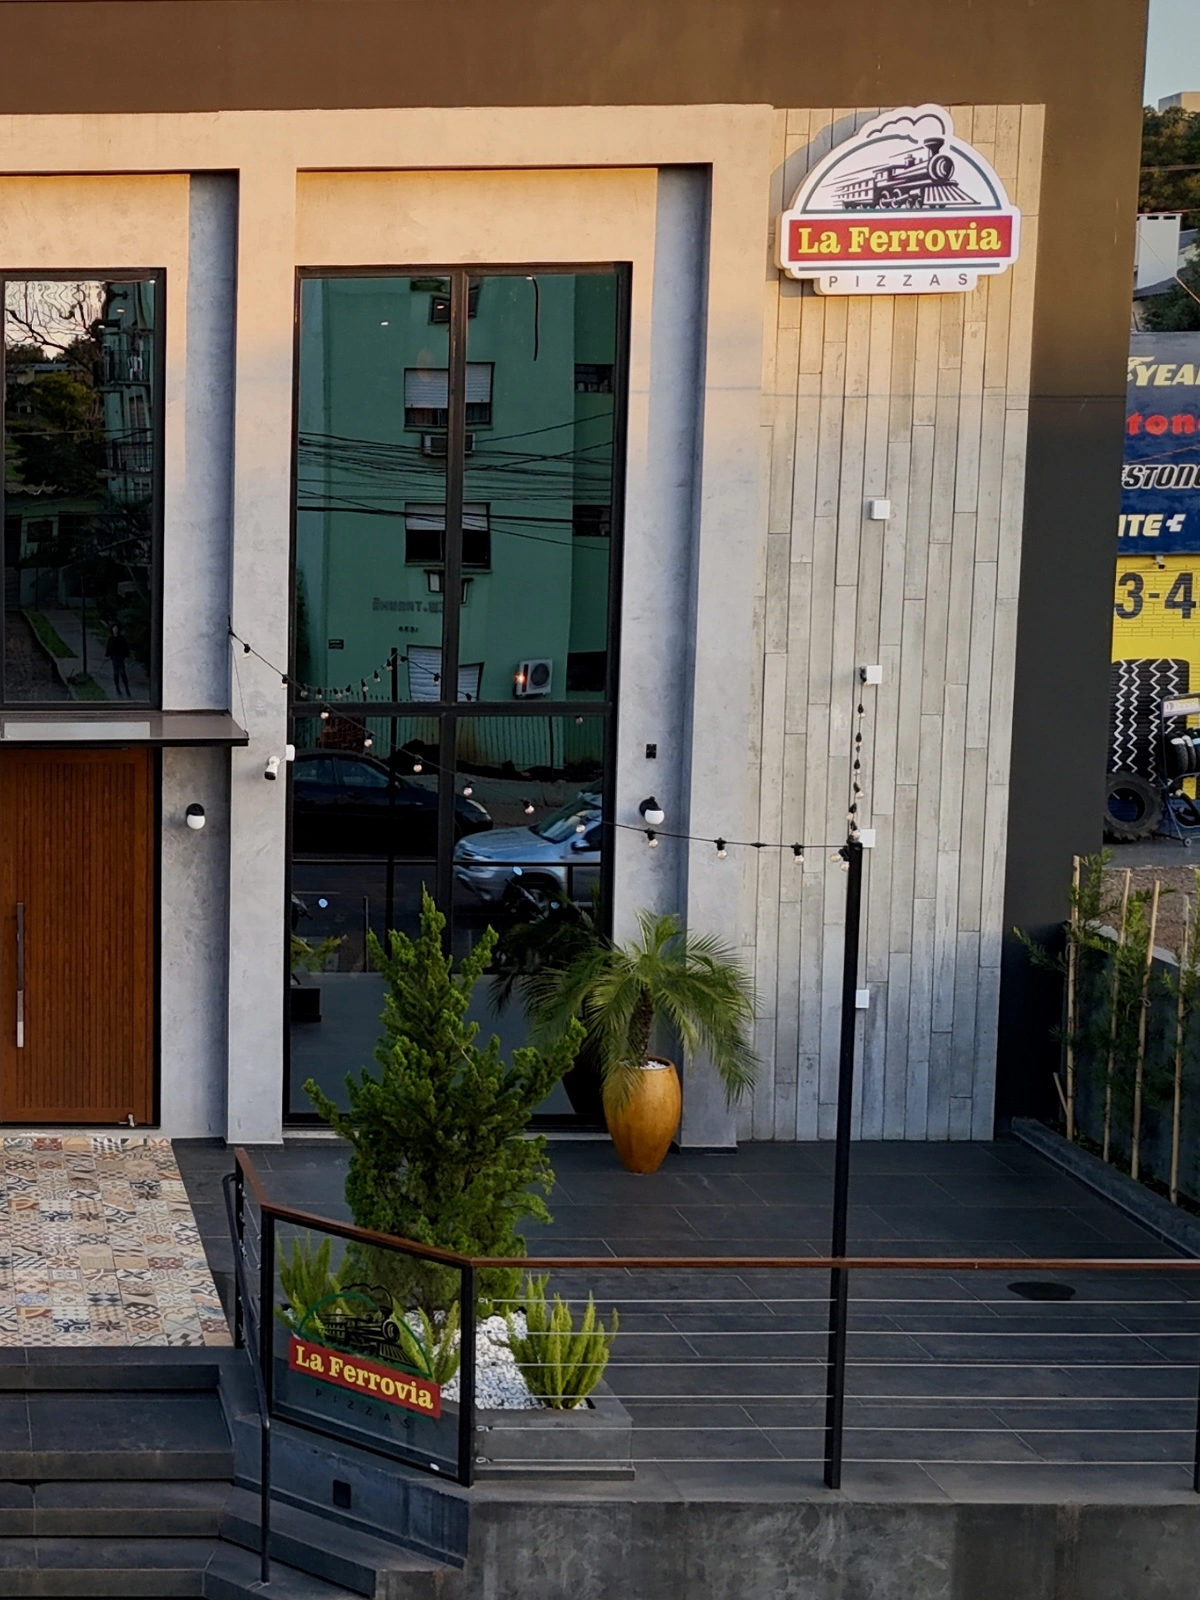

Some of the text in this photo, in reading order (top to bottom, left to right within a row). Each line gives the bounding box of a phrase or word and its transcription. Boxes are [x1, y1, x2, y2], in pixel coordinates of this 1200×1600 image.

[798, 221, 1001, 254] La Ferrovia
[828, 273, 968, 288] PIZZAS
[1135, 363, 1200, 387] YEA
[1127, 411, 1200, 436] ton
[296, 1345, 434, 1409] La Ferrovia
[315, 1388, 411, 1429] PIZZAS
